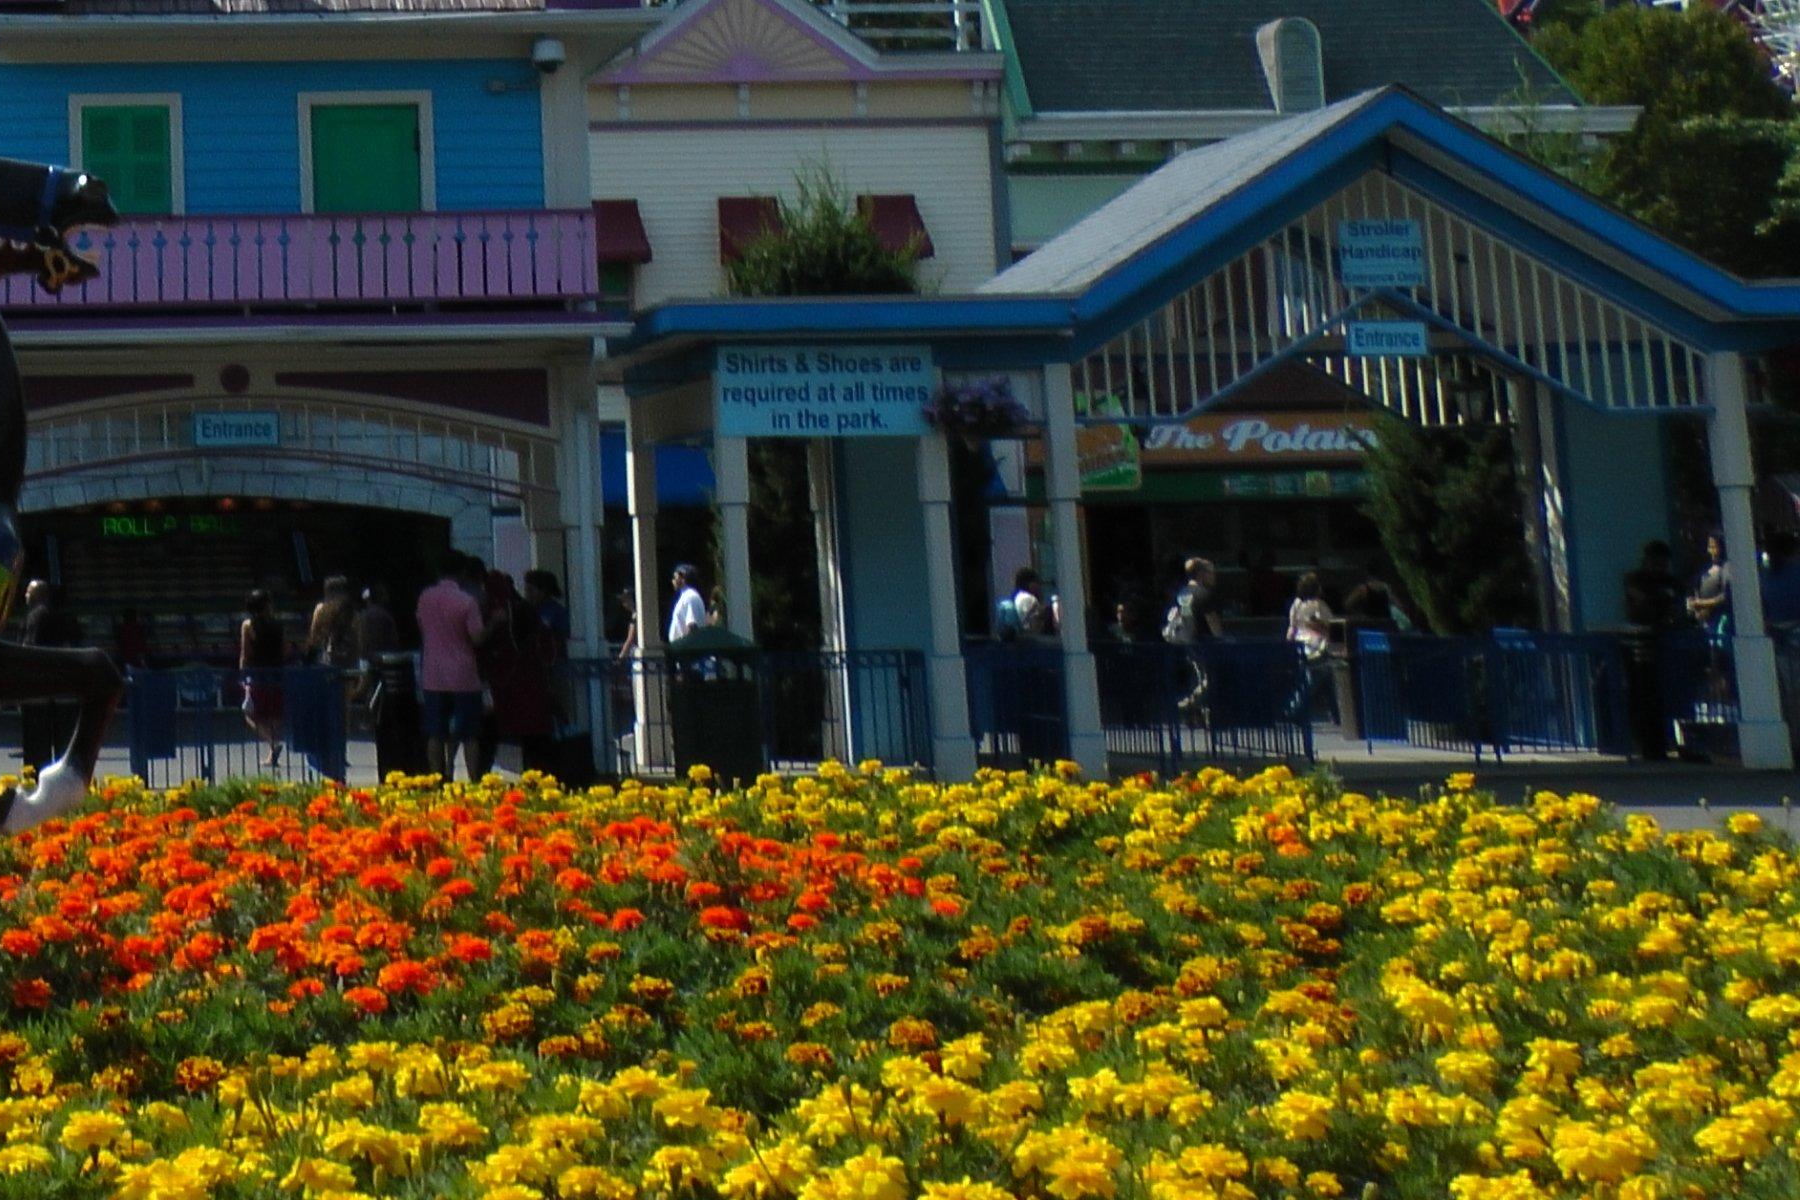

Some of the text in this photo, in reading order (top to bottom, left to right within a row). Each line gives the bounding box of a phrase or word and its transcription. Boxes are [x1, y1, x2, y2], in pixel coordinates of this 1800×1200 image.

[1347, 221, 1410, 236] Stroller
[1341, 244, 1423, 261] Handicap
[1354, 327, 1421, 347] Entrance
[726, 352, 922, 374] Shirts & Shoes are
[722, 382, 929, 408] required at all times
[202, 417, 272, 439] Entrance
[771, 408, 888, 434] in the park.
[1144, 424, 1213, 449] The
[103, 516, 156, 537] ROLL
